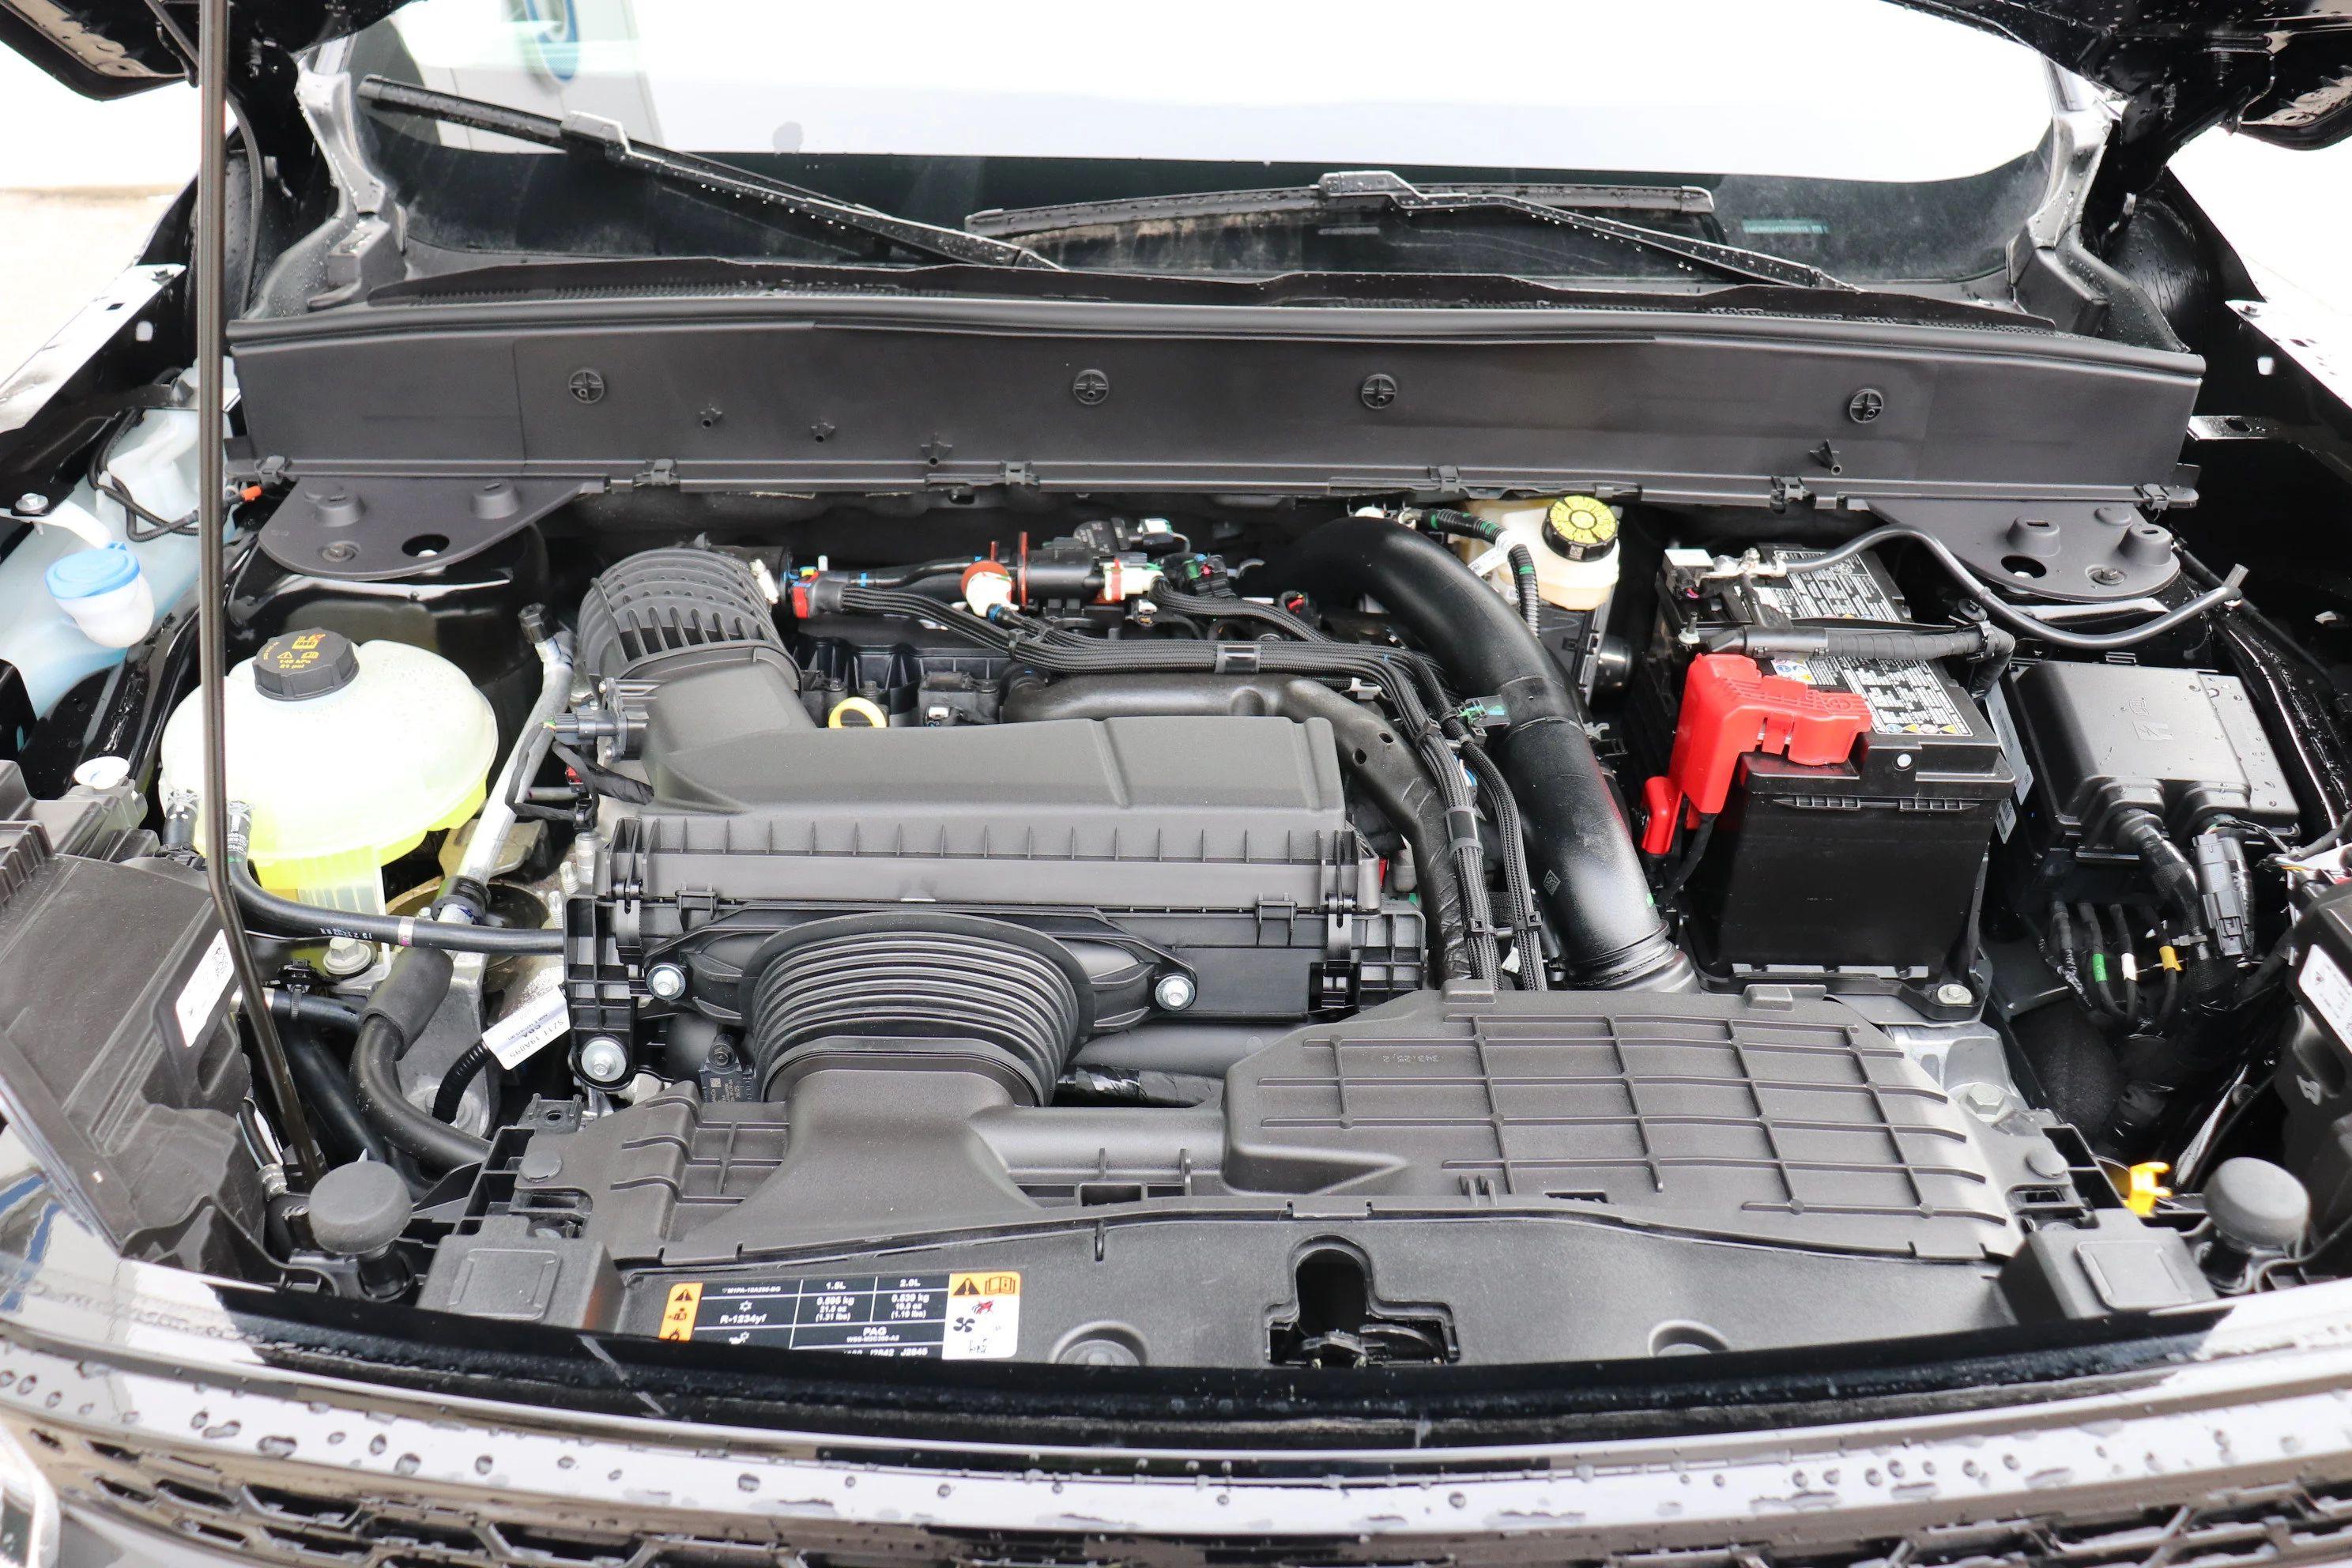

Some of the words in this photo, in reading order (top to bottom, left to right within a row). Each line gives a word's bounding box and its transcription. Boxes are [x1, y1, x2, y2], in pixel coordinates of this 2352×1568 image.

[899, 1278, 921, 1287] 2.0L
[842, 1296, 855, 1306] kg
[918, 1293, 930, 1303] kg
[720, 1314, 767, 1325] R-1234yf
[863, 1326, 887, 1336] PAG
